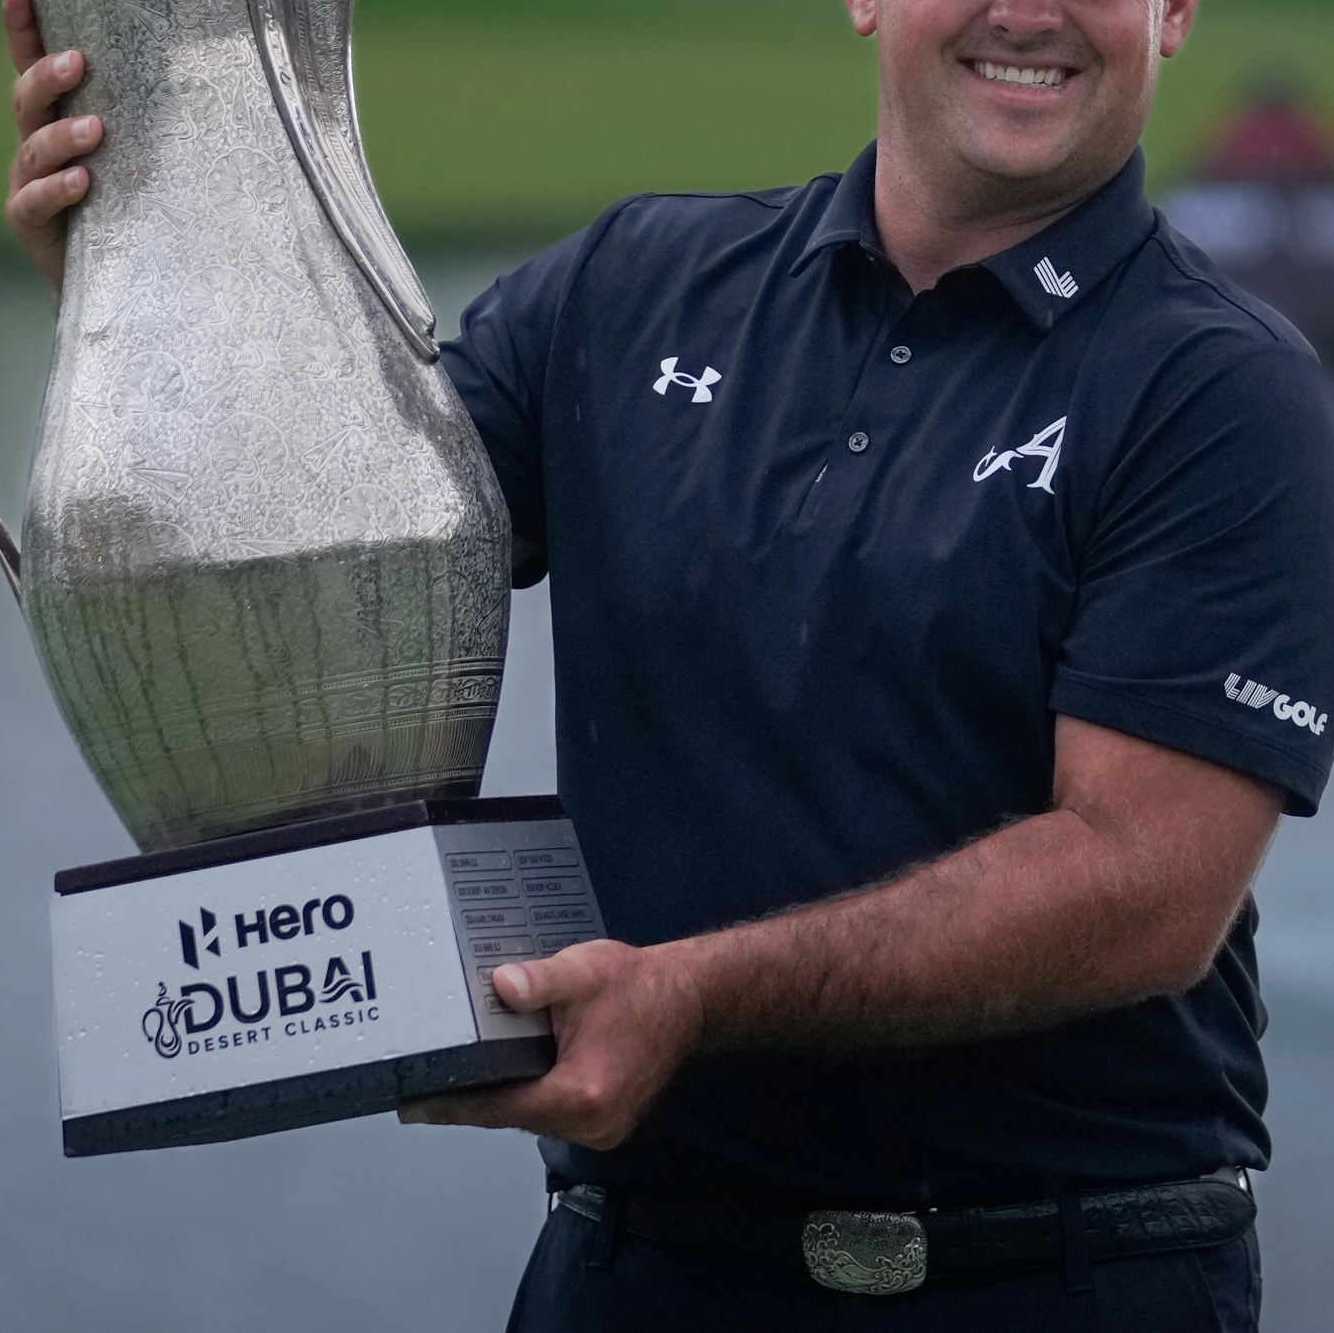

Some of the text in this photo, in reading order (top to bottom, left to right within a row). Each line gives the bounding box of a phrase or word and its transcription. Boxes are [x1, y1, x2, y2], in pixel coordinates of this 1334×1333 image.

[180, 950, 378, 1035] DUBAI
[187, 1006, 381, 1056] DESERT CLASSIC
